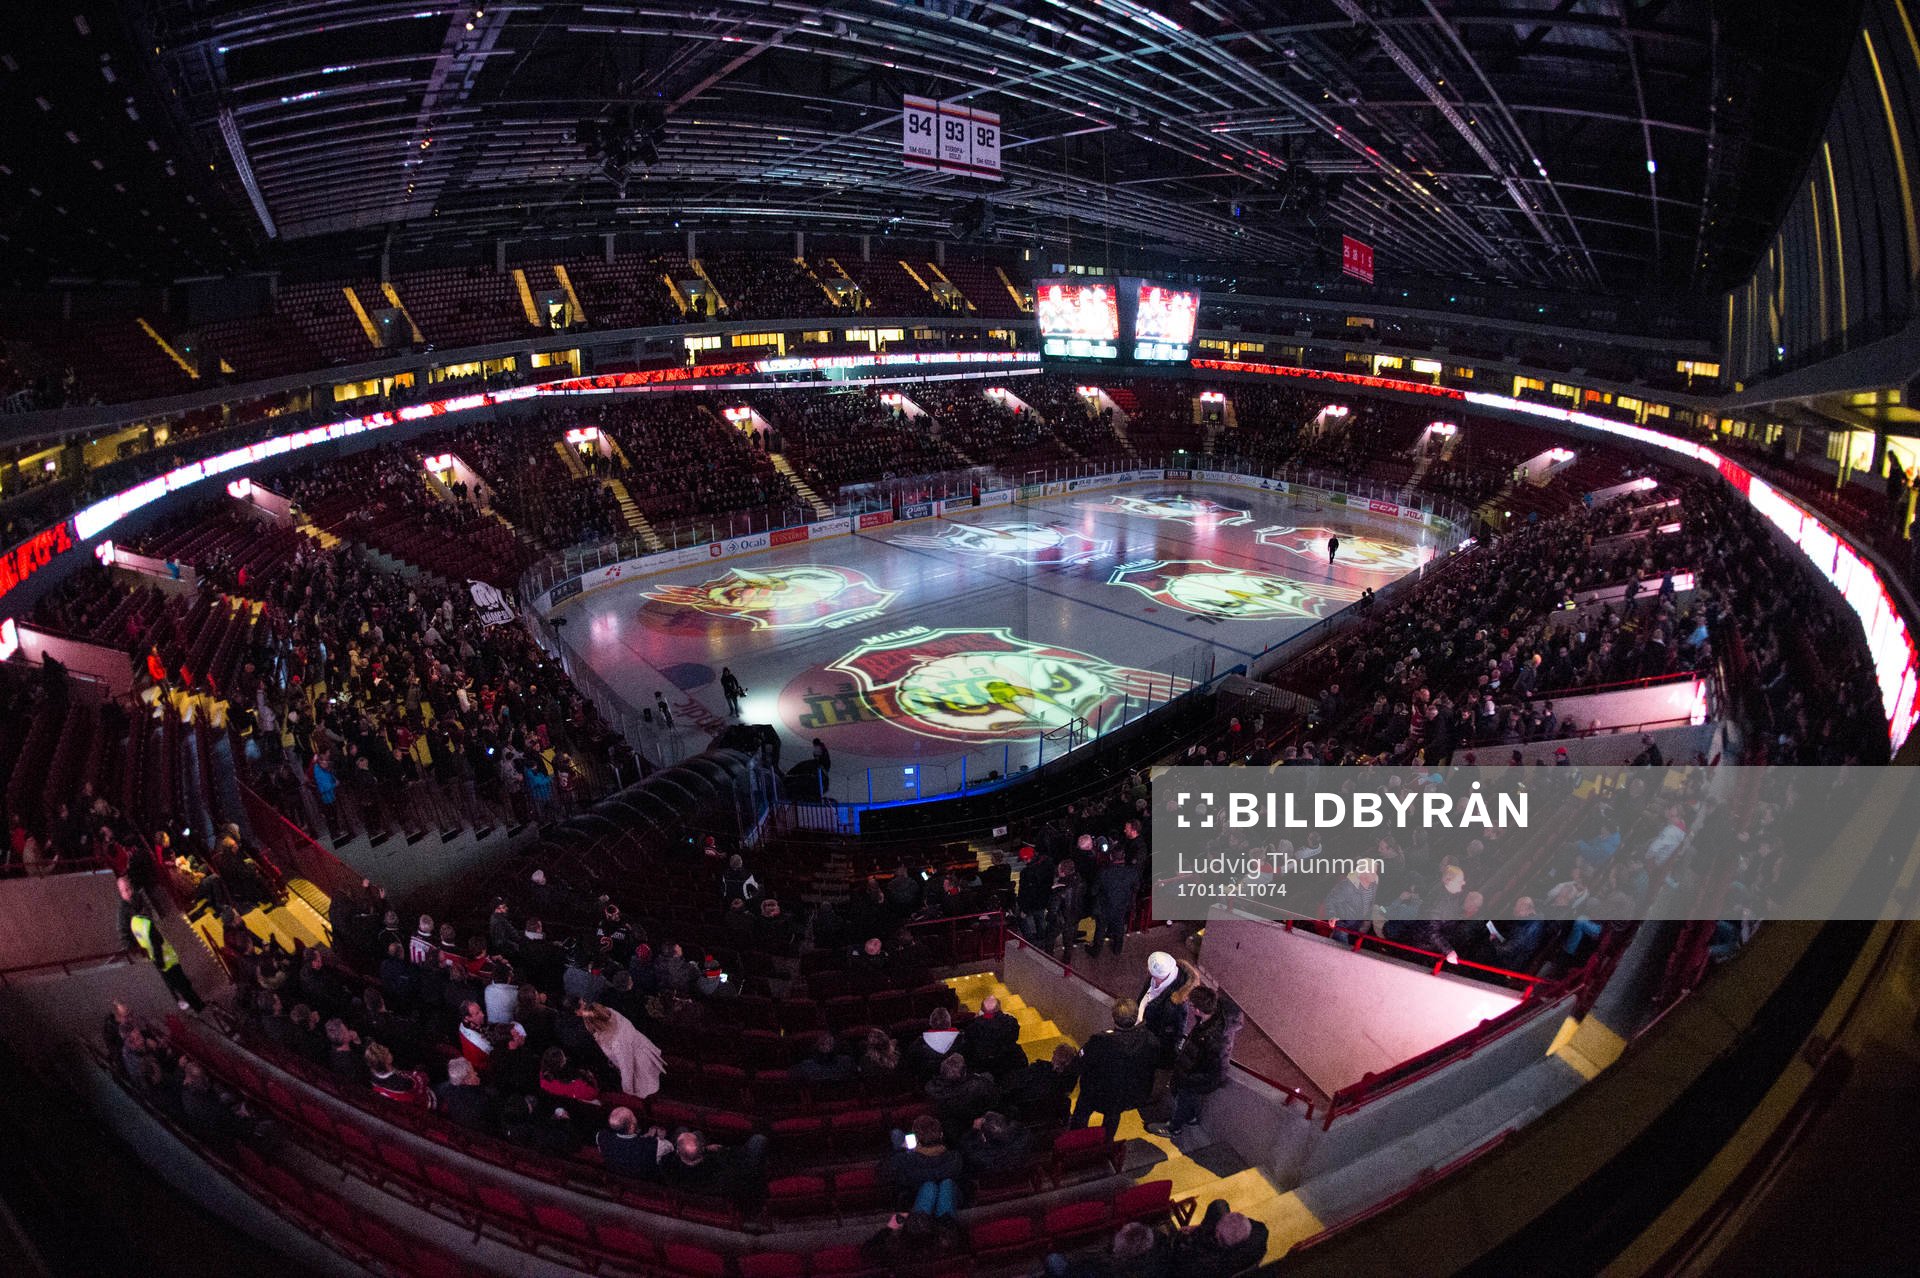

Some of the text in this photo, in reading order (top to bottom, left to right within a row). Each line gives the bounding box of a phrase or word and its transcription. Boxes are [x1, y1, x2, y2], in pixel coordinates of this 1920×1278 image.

[909, 113, 931, 136] 94
[945, 120, 964, 142] 93
[977, 127, 995, 148] 92
[1370, 503, 1398, 513] CCM
[1404, 510, 1423, 520] JULA
[741, 538, 767, 549] Ocab
